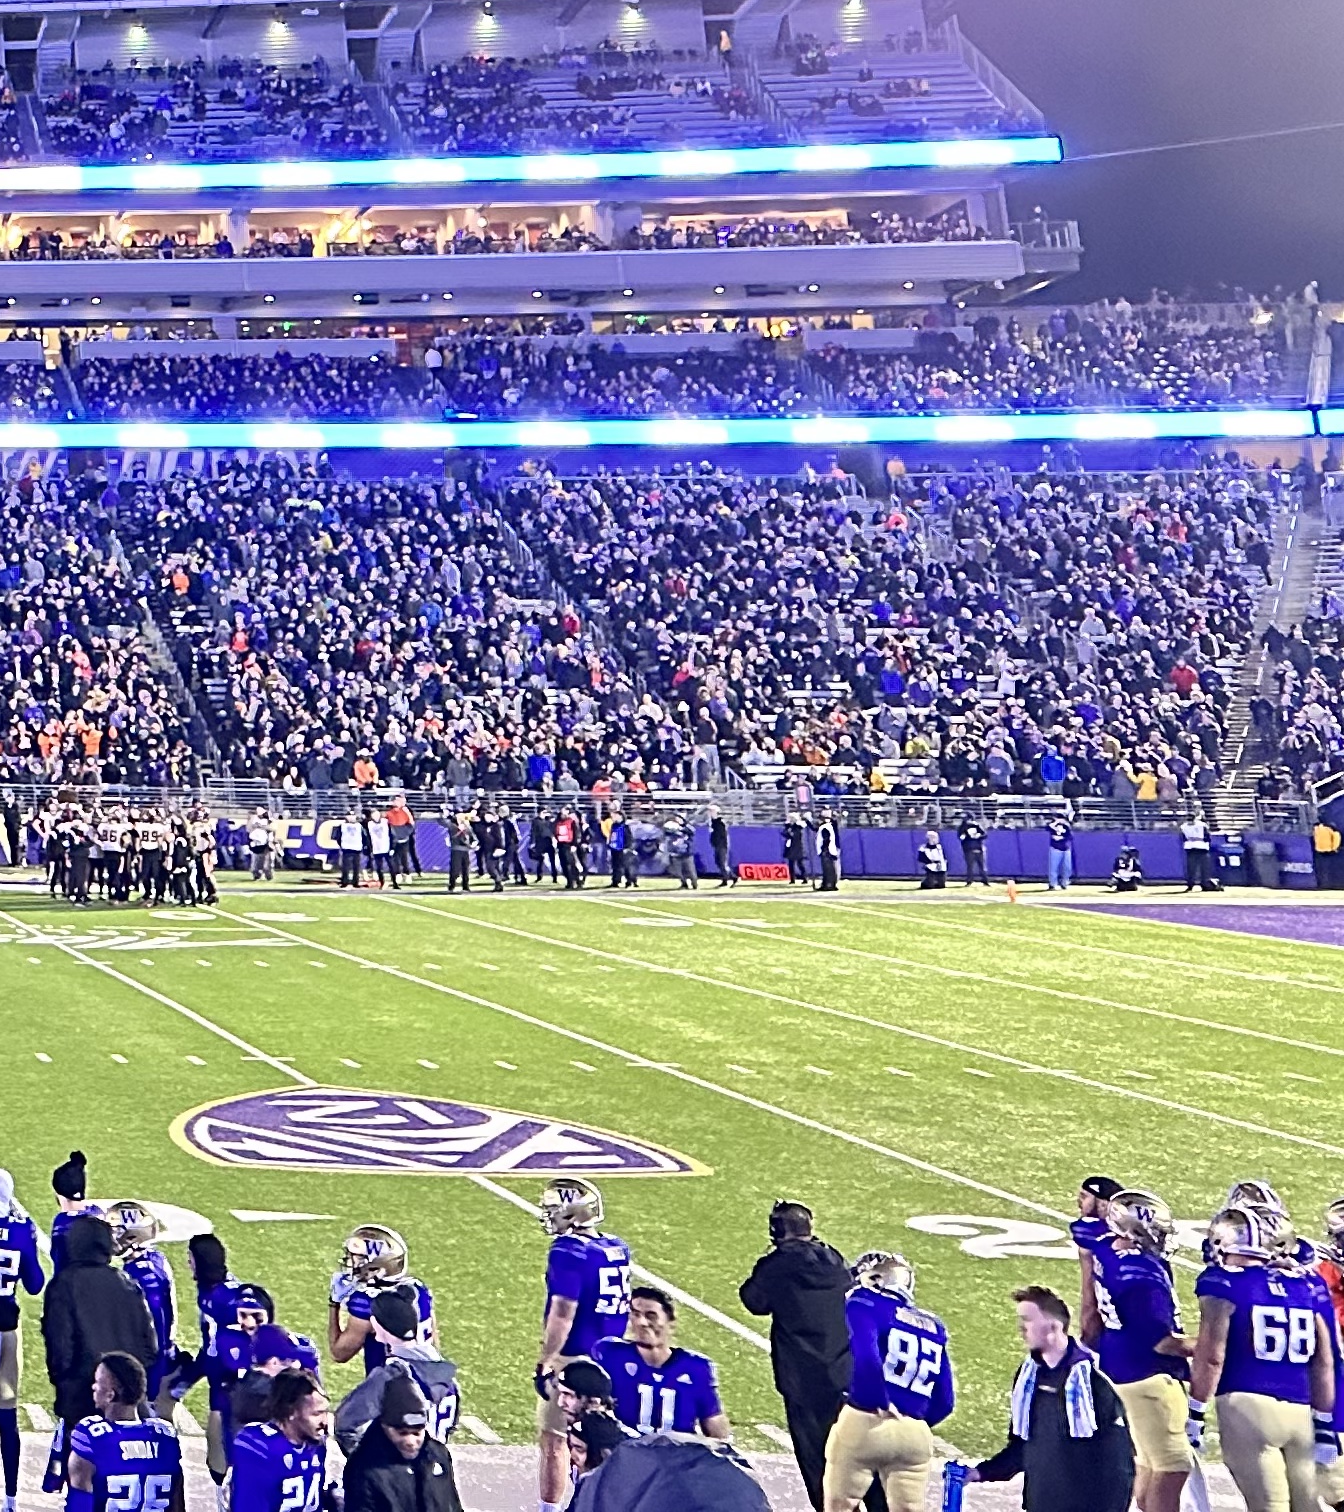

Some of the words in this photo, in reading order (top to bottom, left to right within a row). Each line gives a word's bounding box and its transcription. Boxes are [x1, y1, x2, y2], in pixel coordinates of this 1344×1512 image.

[883, 1327, 944, 1396] 82
[1251, 1304, 1316, 1364] 68
[637, 1384, 677, 1434] 11
